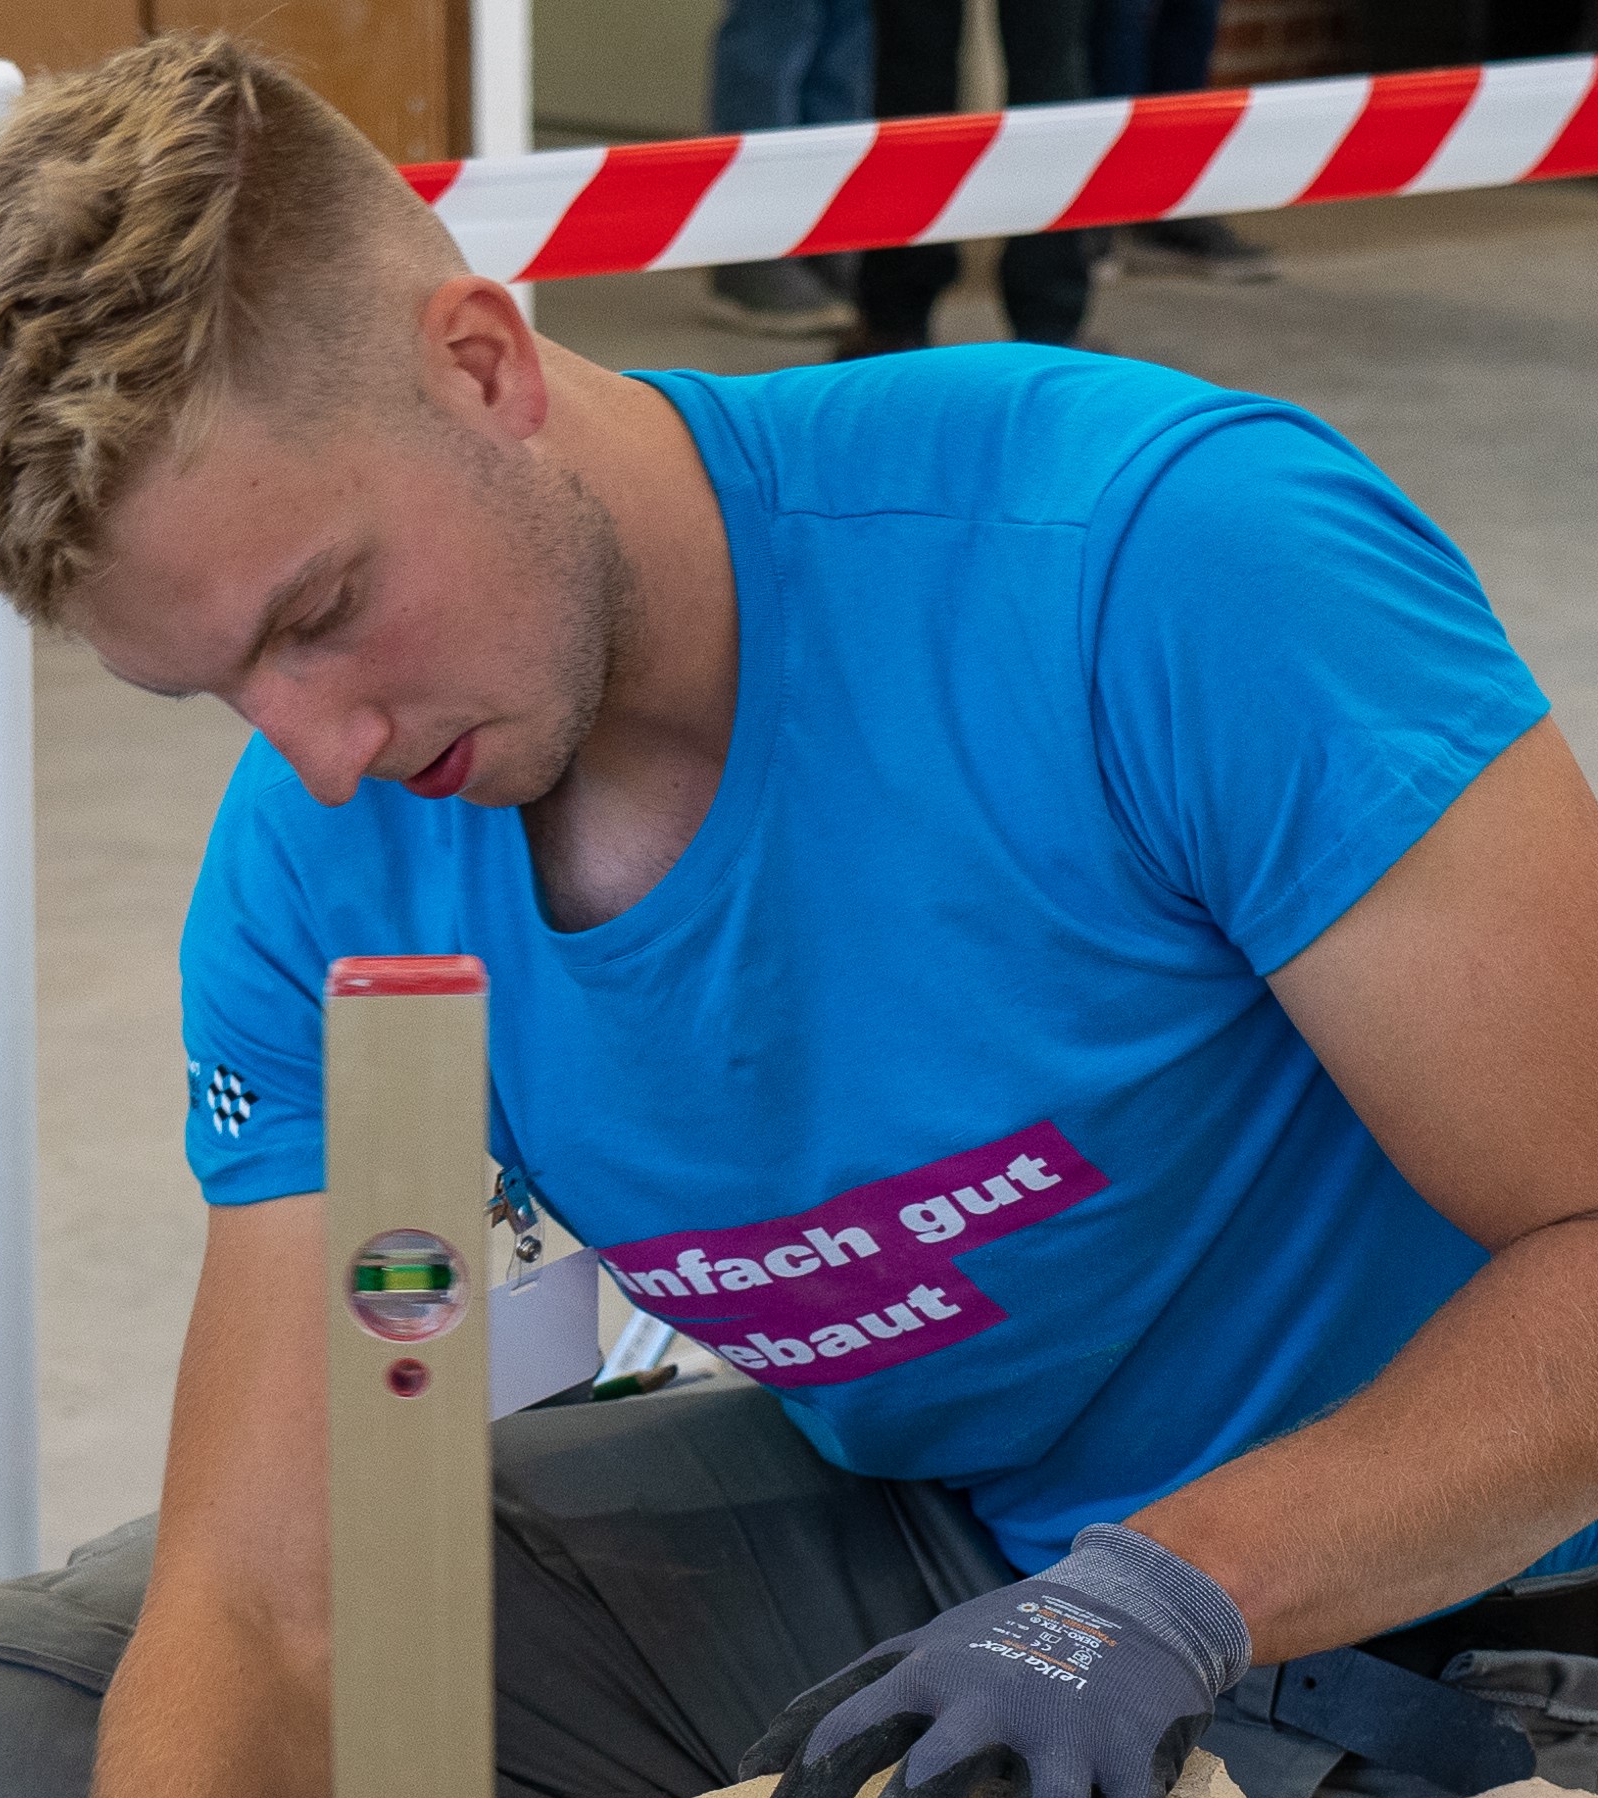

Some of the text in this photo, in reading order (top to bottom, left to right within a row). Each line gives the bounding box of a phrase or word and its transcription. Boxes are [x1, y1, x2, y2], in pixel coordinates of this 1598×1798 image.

[604, 1153, 1063, 1298] infach gut
[696, 1283, 961, 1369] ebaut
